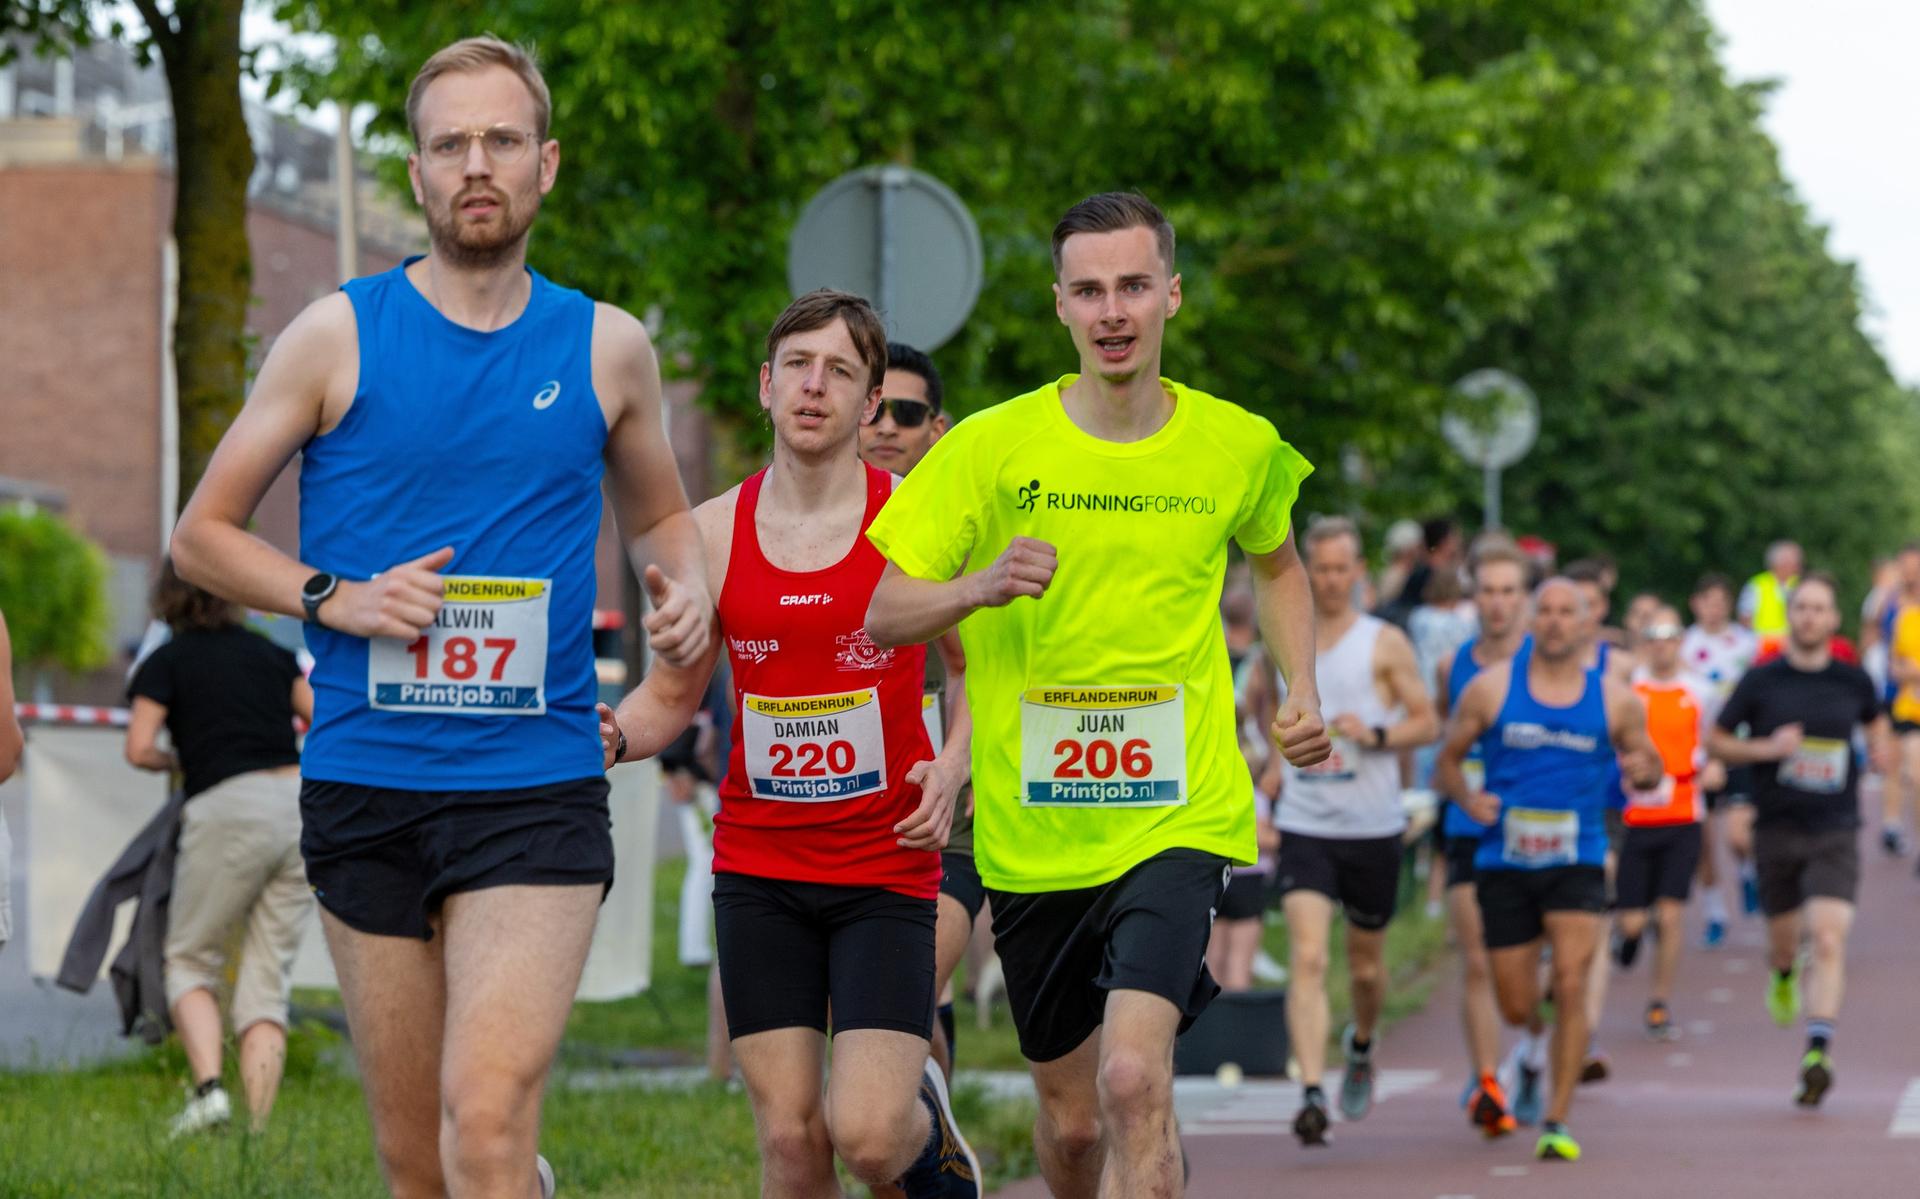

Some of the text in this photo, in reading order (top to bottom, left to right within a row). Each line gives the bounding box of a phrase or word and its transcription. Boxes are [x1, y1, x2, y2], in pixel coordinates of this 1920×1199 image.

[1047, 492, 1217, 515] RUNNINGFORYOU
[444, 581, 526, 597] NDENRUN
[779, 594, 822, 606] CRAFT
[406, 635, 516, 681] 187
[400, 684, 517, 707] Printjob.nl
[757, 696, 855, 713] ERFLANDENRUN
[1044, 690, 1158, 704] ERFLANDENRUN
[774, 719, 840, 739] DAMIAN
[1077, 715, 1125, 733] JUAN
[768, 740, 857, 778] 220
[1053, 738, 1153, 780] 206
[771, 775, 861, 798] Printjob.nl
[1051, 780, 1155, 803] Printjob.nl
